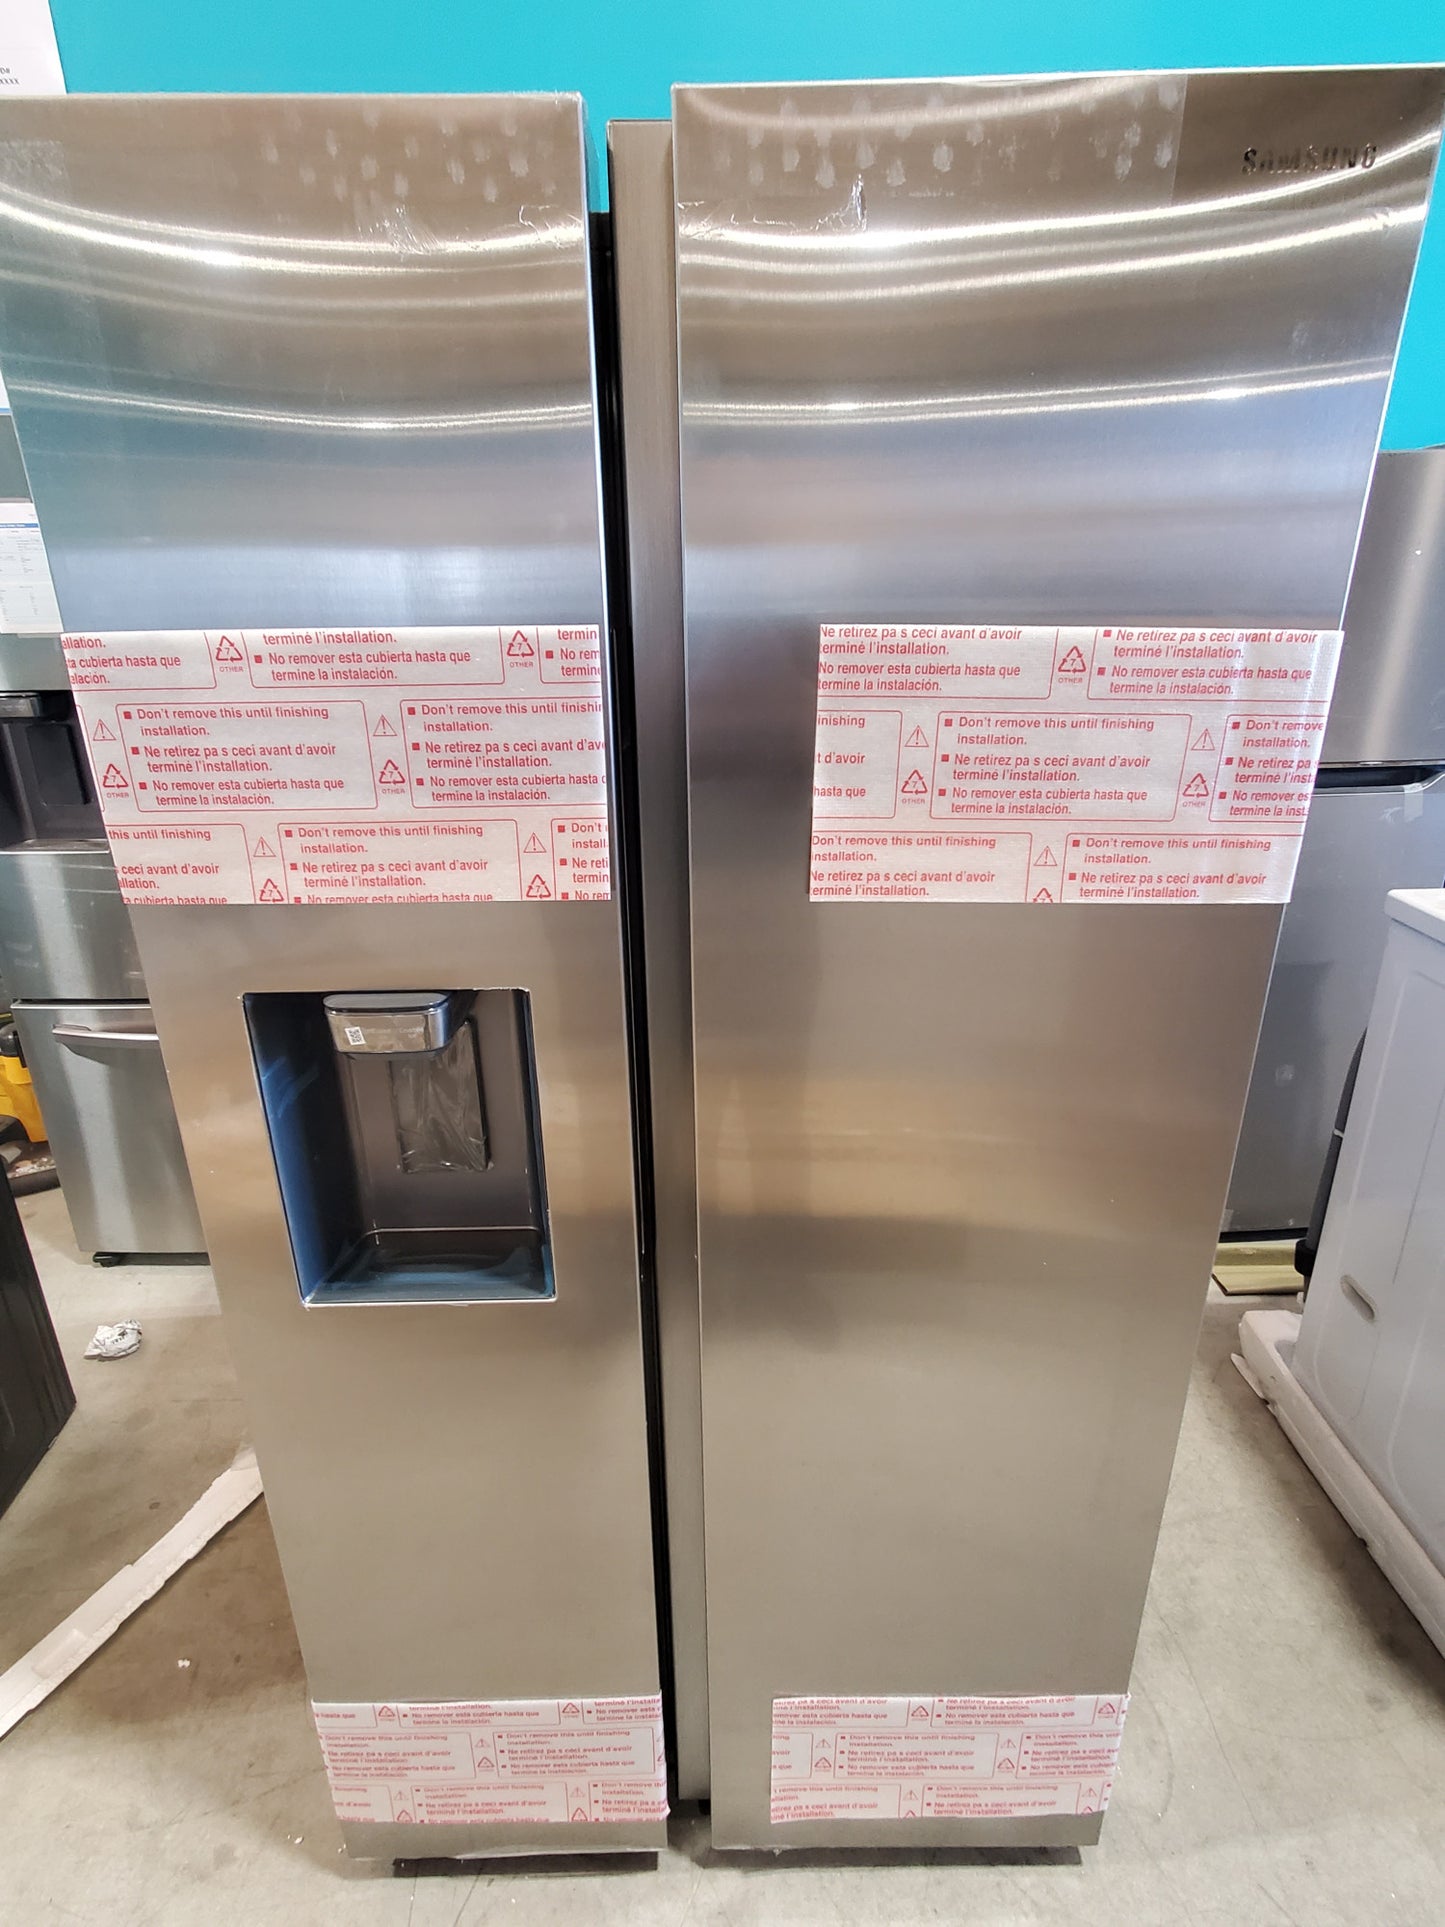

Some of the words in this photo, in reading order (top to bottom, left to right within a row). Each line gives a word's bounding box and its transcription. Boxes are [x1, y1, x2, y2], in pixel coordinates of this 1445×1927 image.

[1242, 143, 1377, 174] SAMSUNG
[262, 634, 313, 646] terminé
[315, 632, 396, 644] l'installation.
[268, 653, 286, 665] No
[287, 654, 334, 665] remover
[337, 652, 363, 664] esta
[365, 652, 413, 664] cubierta
[414, 651, 448, 663] hasta
[448, 652, 471, 663] que
[1113, 646, 1163, 658] terminé
[1165, 646, 1242, 659] l'installation.
[77, 657, 123, 668] cubierta
[123, 656, 158, 668] hasta
[159, 656, 181, 668] que
[271, 670, 316, 681] termine
[317, 669, 329, 681] la
[330, 668, 398, 680] instalación.
[817, 661, 834, 674] No
[837, 664, 884, 674] remover
[886, 664, 912, 675] esta
[914, 664, 962, 676] cubierta
[962, 664, 997, 676] hasta
[997, 666, 1021, 677] que
[1111, 665, 1129, 677] No
[1130, 667, 1179, 678] remover
[1180, 668, 1206, 679] esta
[1207, 667, 1254, 679] cubierta
[1255, 667, 1288, 680] hasta
[1290, 669, 1311, 682] que
[816, 680, 861, 691] termine
[863, 680, 875, 691] la
[877, 680, 942, 691] instalación.
[1109, 682, 1153, 694] termine
[1155, 683, 1167, 694] la
[1168, 683, 1233, 695] instalación.
[136, 708, 170, 720] Don't
[172, 709, 217, 719] remove
[218, 707, 243, 719] this
[245, 707, 274, 718] until
[274, 706, 329, 720] finishing
[421, 703, 454, 716] Don't
[456, 705, 502, 715] remove
[504, 703, 528, 714] this
[529, 702, 558, 713] until
[423, 721, 493, 732] installation.
[958, 715, 992, 728] Don't
[994, 718, 1041, 728] remove
[1043, 718, 1066, 729] this
[1069, 718, 1099, 729] until
[1101, 718, 1154, 732] finishing
[1245, 718, 1279, 731] Don't
[141, 725, 210, 736] installation.
[957, 734, 1027, 745] installation.
[1242, 737, 1311, 748] installation.
[143, 745, 161, 758] Ne
[163, 746, 201, 758] retirez
[230, 746, 257, 758] ceci
[258, 744, 294, 756] avant
[293, 744, 336, 755] d'avoir
[147, 762, 194, 773] terminé
[195, 759, 271, 772] l'installation.
[426, 757, 472, 768] terminé
[475, 756, 551, 768] l'installation.
[954, 754, 970, 765] Ne
[973, 755, 1012, 766] retirez
[1042, 755, 1070, 768] ceci
[1071, 756, 1106, 767] avant
[1108, 755, 1150, 768] d'avoir
[952, 769, 998, 780] terminé
[1001, 768, 1079, 781] l'installation.
[152, 779, 169, 791] No
[171, 781, 215, 791] remover
[217, 780, 243, 791] esta
[242, 779, 288, 790] cubierta
[289, 778, 322, 789] hasta
[321, 778, 344, 790] que
[156, 795, 197, 805] termine
[199, 794, 210, 806] la
[212, 794, 274, 805] instalación.
[431, 791, 473, 801] termine
[475, 790, 486, 801] la
[488, 789, 550, 800] instalación.
[952, 786, 968, 798] No
[971, 788, 1015, 799] remover
[1018, 789, 1043, 799] esta
[1044, 789, 1091, 800] cubierta
[1093, 789, 1125, 800] hasta
[1125, 790, 1147, 802] que
[951, 803, 993, 813] termine
[994, 804, 1006, 814] la
[1008, 803, 1071, 815] instalación.
[107, 829, 130, 840] this
[131, 828, 160, 840] until
[159, 828, 211, 840] finishing
[297, 825, 329, 838] Don't
[332, 826, 377, 836] remove
[379, 824, 401, 836] this
[404, 824, 430, 835] until
[433, 823, 484, 837] finishing
[300, 843, 368, 854] installation.
[810, 835, 842, 846] Don't
[844, 836, 888, 846] remove
[890, 835, 914, 847] this
[916, 835, 944, 846] until
[945, 835, 996, 849] finishing
[120, 865, 144, 876] ceci
[146, 864, 179, 876] avant
[180, 864, 220, 875] d'avoir
[303, 877, 349, 888] terminé
[351, 875, 426, 887] l'installation.
[1079, 872, 1097, 884] Ne
[1099, 873, 1136, 885] retirez
[1166, 874, 1190, 885] ceci
[1192, 874, 1225, 885] avant
[1226, 873, 1267, 885] d'avoir
[1079, 887, 1126, 897] terminé
[1126, 886, 1200, 898] l'installation.
